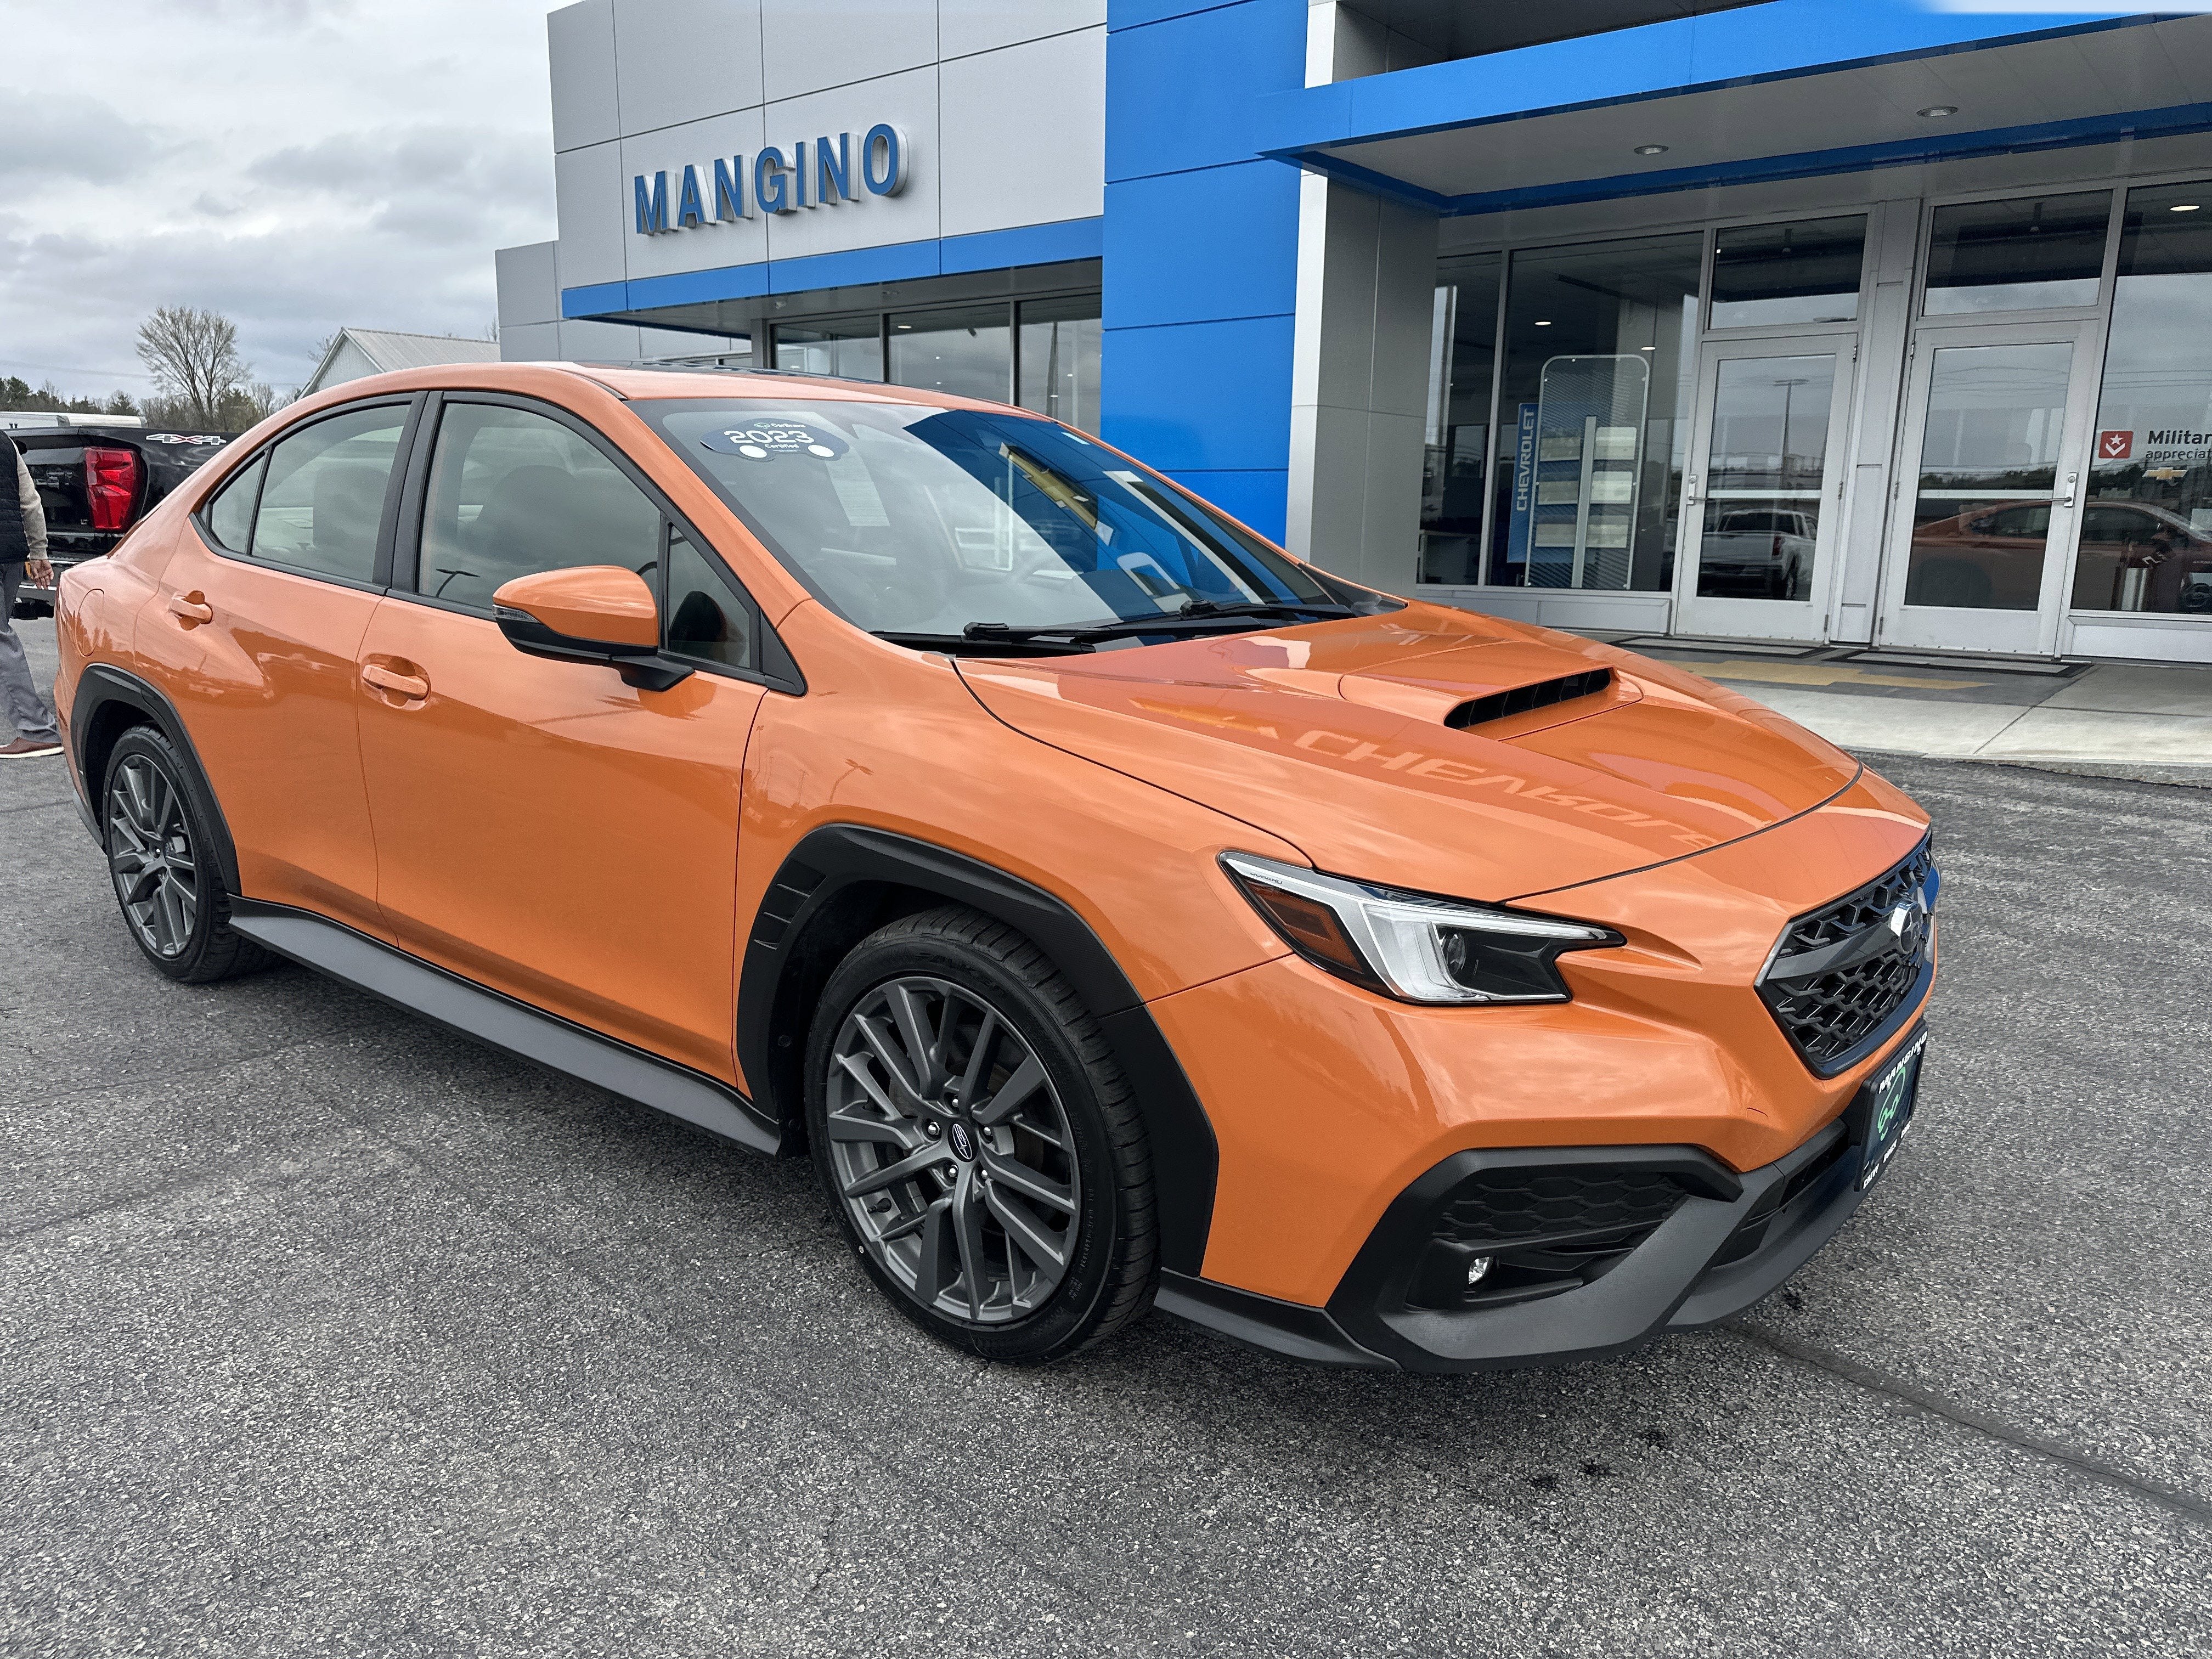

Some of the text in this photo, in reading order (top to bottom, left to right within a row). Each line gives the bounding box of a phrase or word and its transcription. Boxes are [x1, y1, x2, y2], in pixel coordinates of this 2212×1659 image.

[634, 123, 907, 234] MANGINO
[724, 430, 815, 443] 2023
[2146, 448, 2212, 461] appreciat
[2148, 430, 2212, 444] Militar
[1517, 409, 1535, 511] CHEVROLET
[1878, 1031, 1928, 1094] MANGINO
